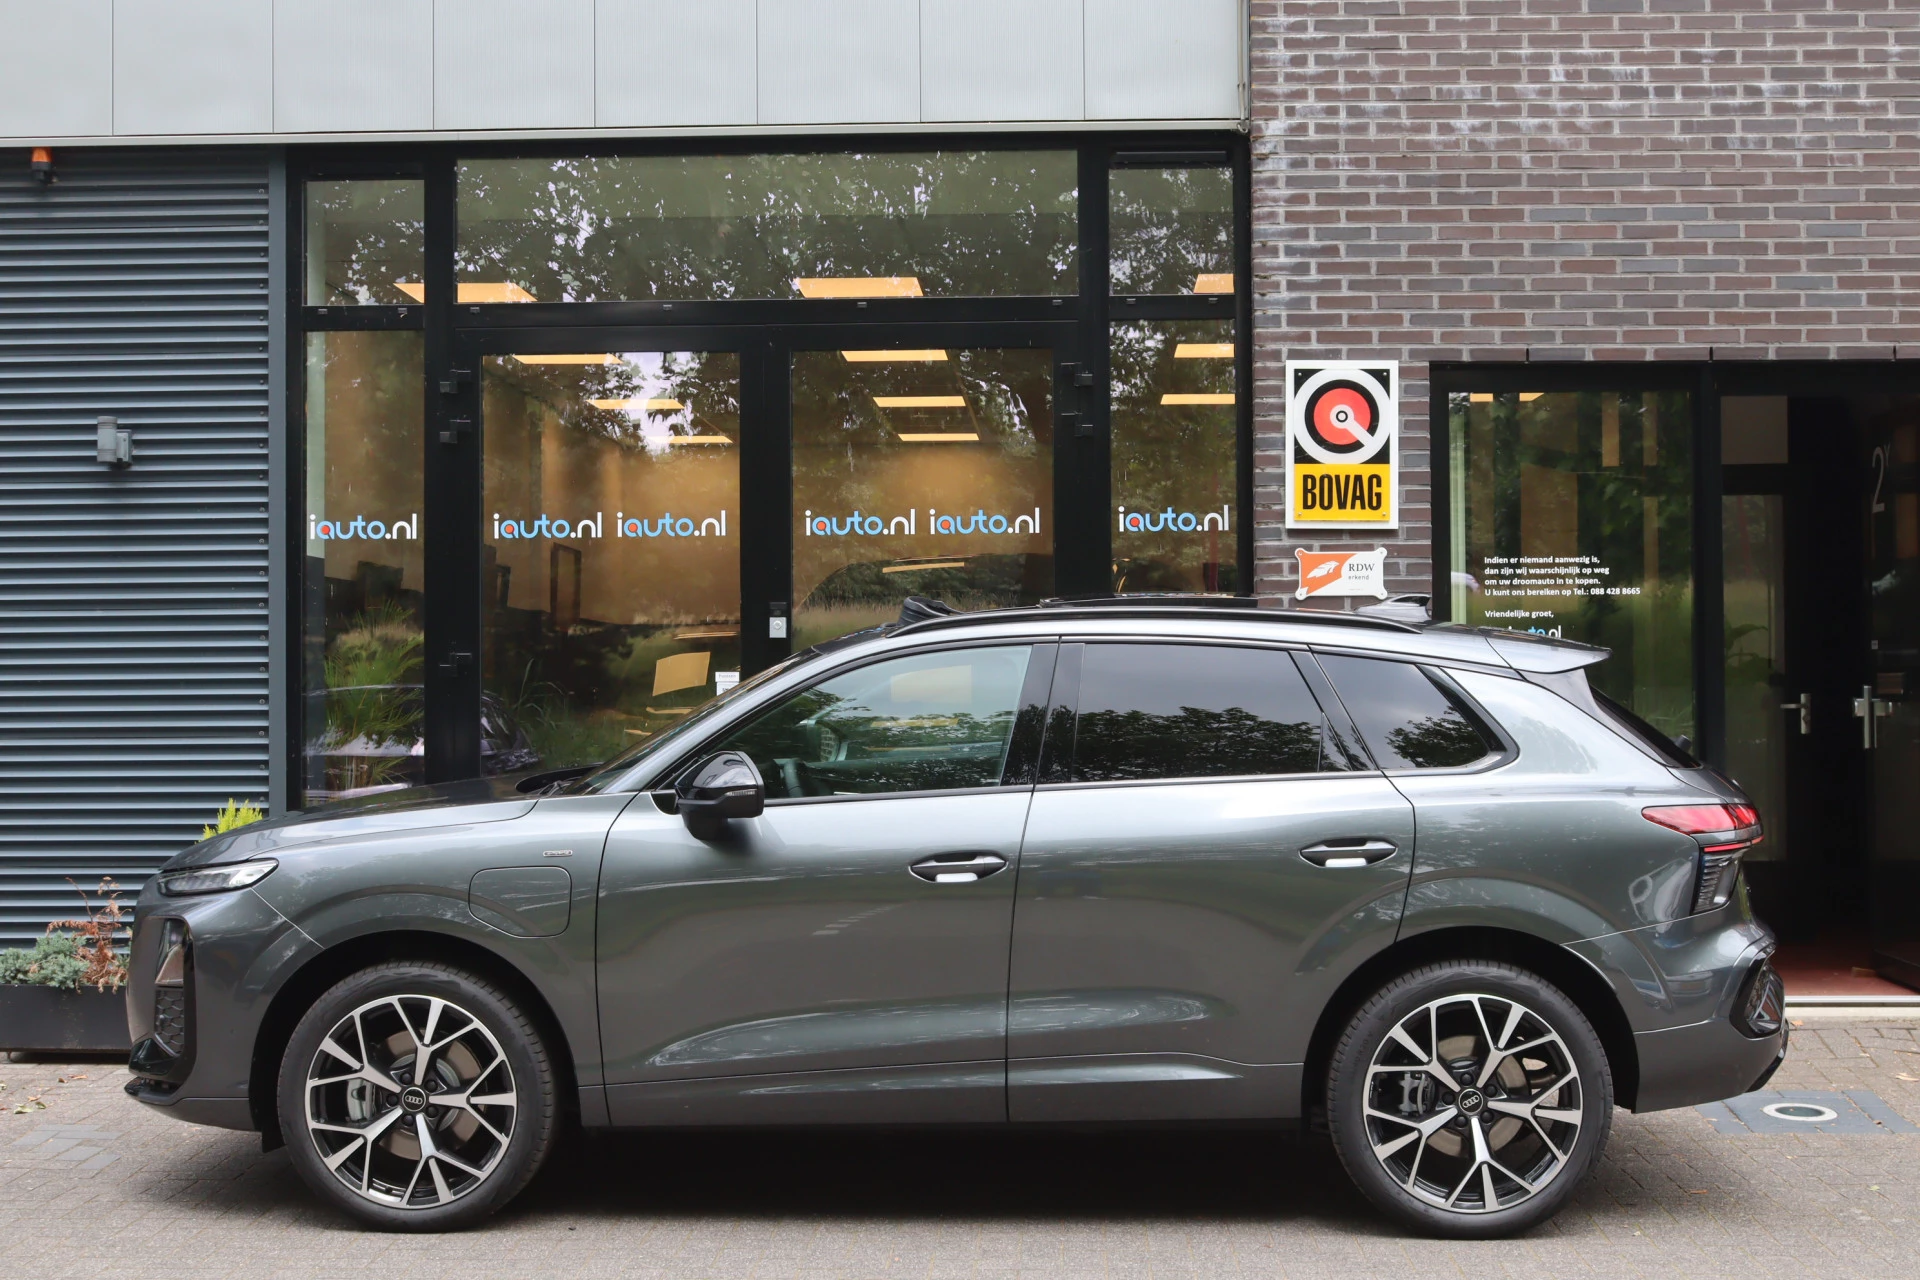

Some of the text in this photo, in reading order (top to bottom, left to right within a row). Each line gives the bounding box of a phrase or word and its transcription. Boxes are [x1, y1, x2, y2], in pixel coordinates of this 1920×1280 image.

[1302, 473, 1382, 511] BOVAG
[805, 507, 1040, 536] iauto.nl iauto.nl
[1118, 504, 1229, 533] iauto.nl
[309, 513, 417, 540] iauto.nl
[493, 510, 726, 539] iauto.nl iauto.nl
[1484, 556, 1508, 564] Indien
[1520, 556, 1553, 564] niemand
[1554, 556, 1590, 564] aanwezig
[1591, 555, 1600, 564] is,
[1348, 563, 1376, 572] RDW
[1484, 566, 1610, 576] dan zijn wij waarschijnlijk op weg
[1512, 577, 1555, 585] droomauto
[1575, 577, 1601, 585] kopen.
[1492, 588, 1510, 596] kunt
[1526, 588, 1560, 596] bereiken
[1590, 587, 1605, 595] 088
[1606, 587, 1621, 595] 428
[1621, 587, 1641, 595] 8665
[1484, 609, 1554, 619] Vriendelijke groet,
